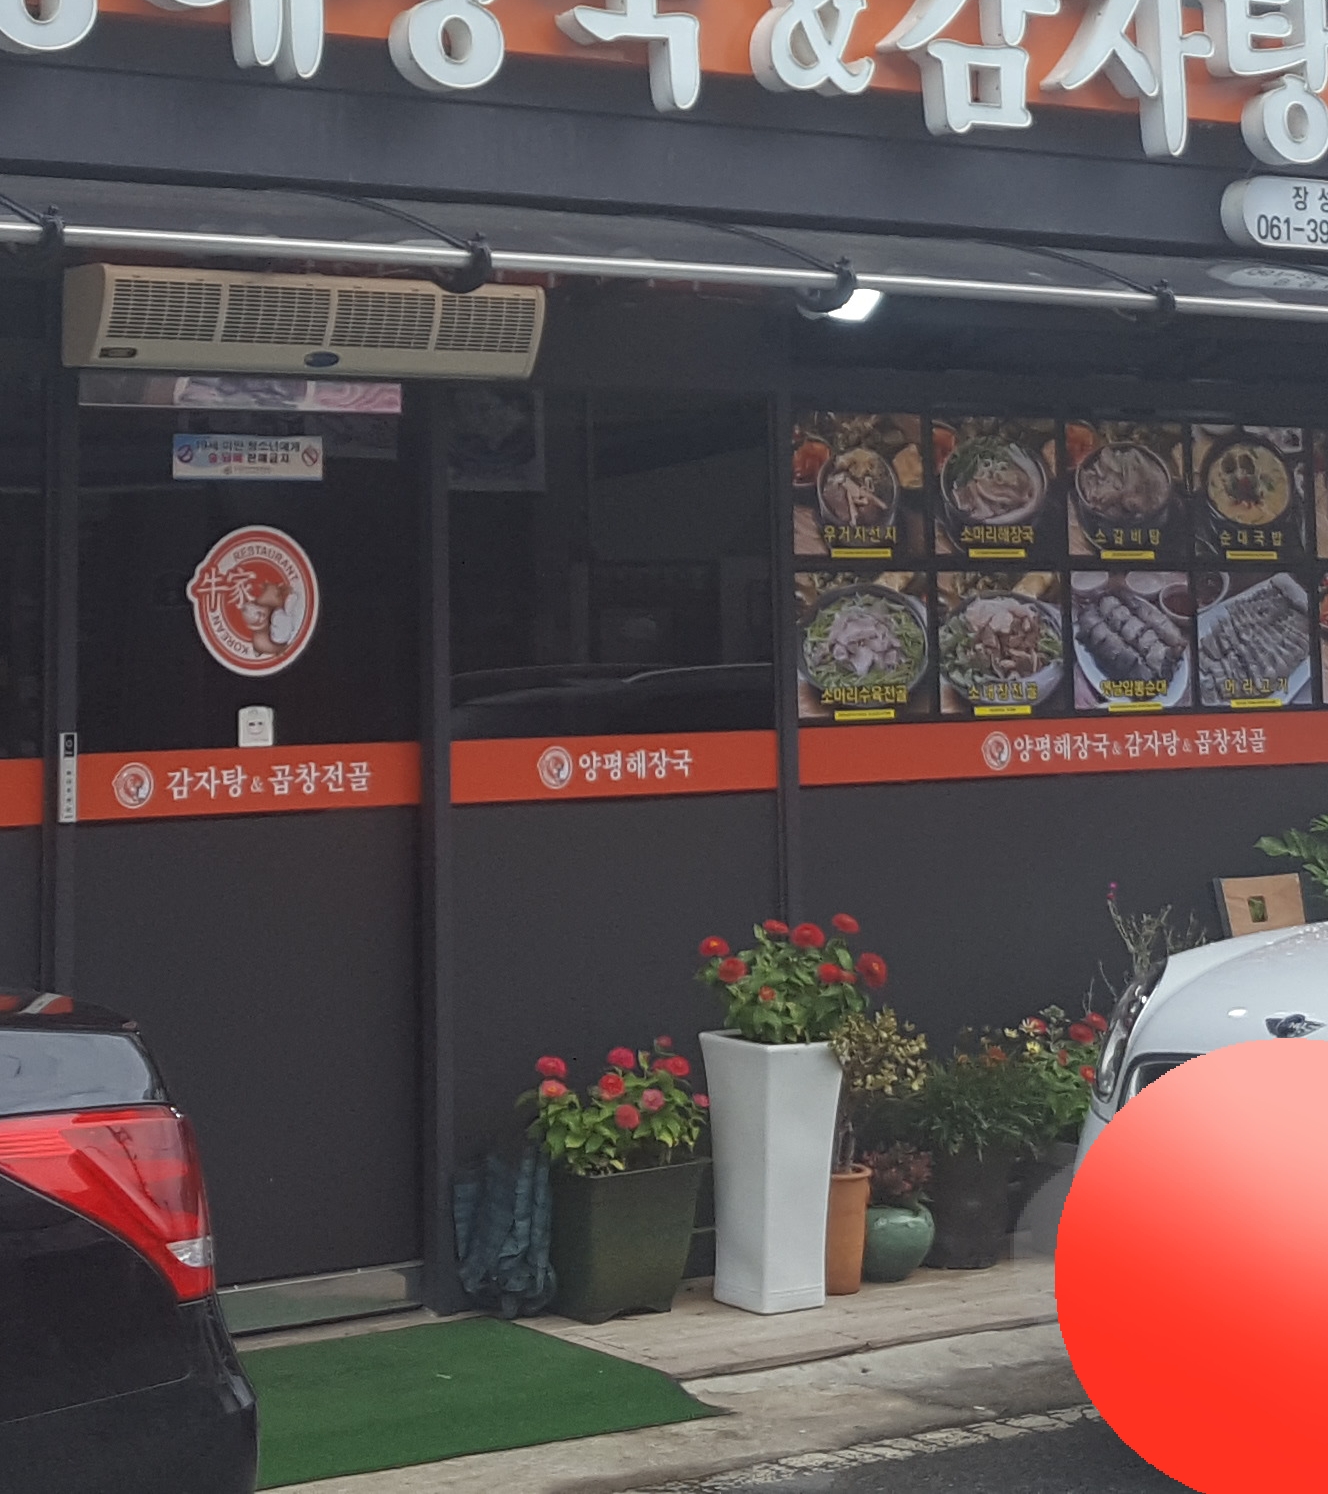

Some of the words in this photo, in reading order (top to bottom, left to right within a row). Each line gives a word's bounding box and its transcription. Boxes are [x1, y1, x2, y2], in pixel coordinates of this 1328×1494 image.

[960, 525, 1035, 544] 소머리해장국
[232, 545, 299, 581] RESTAURANT
[211, 615, 250, 655] KOREAN
[166, 766, 247, 801] 감자탕
[267, 761, 372, 795] 곱창전골
[578, 748, 693, 782] 양평해장국
